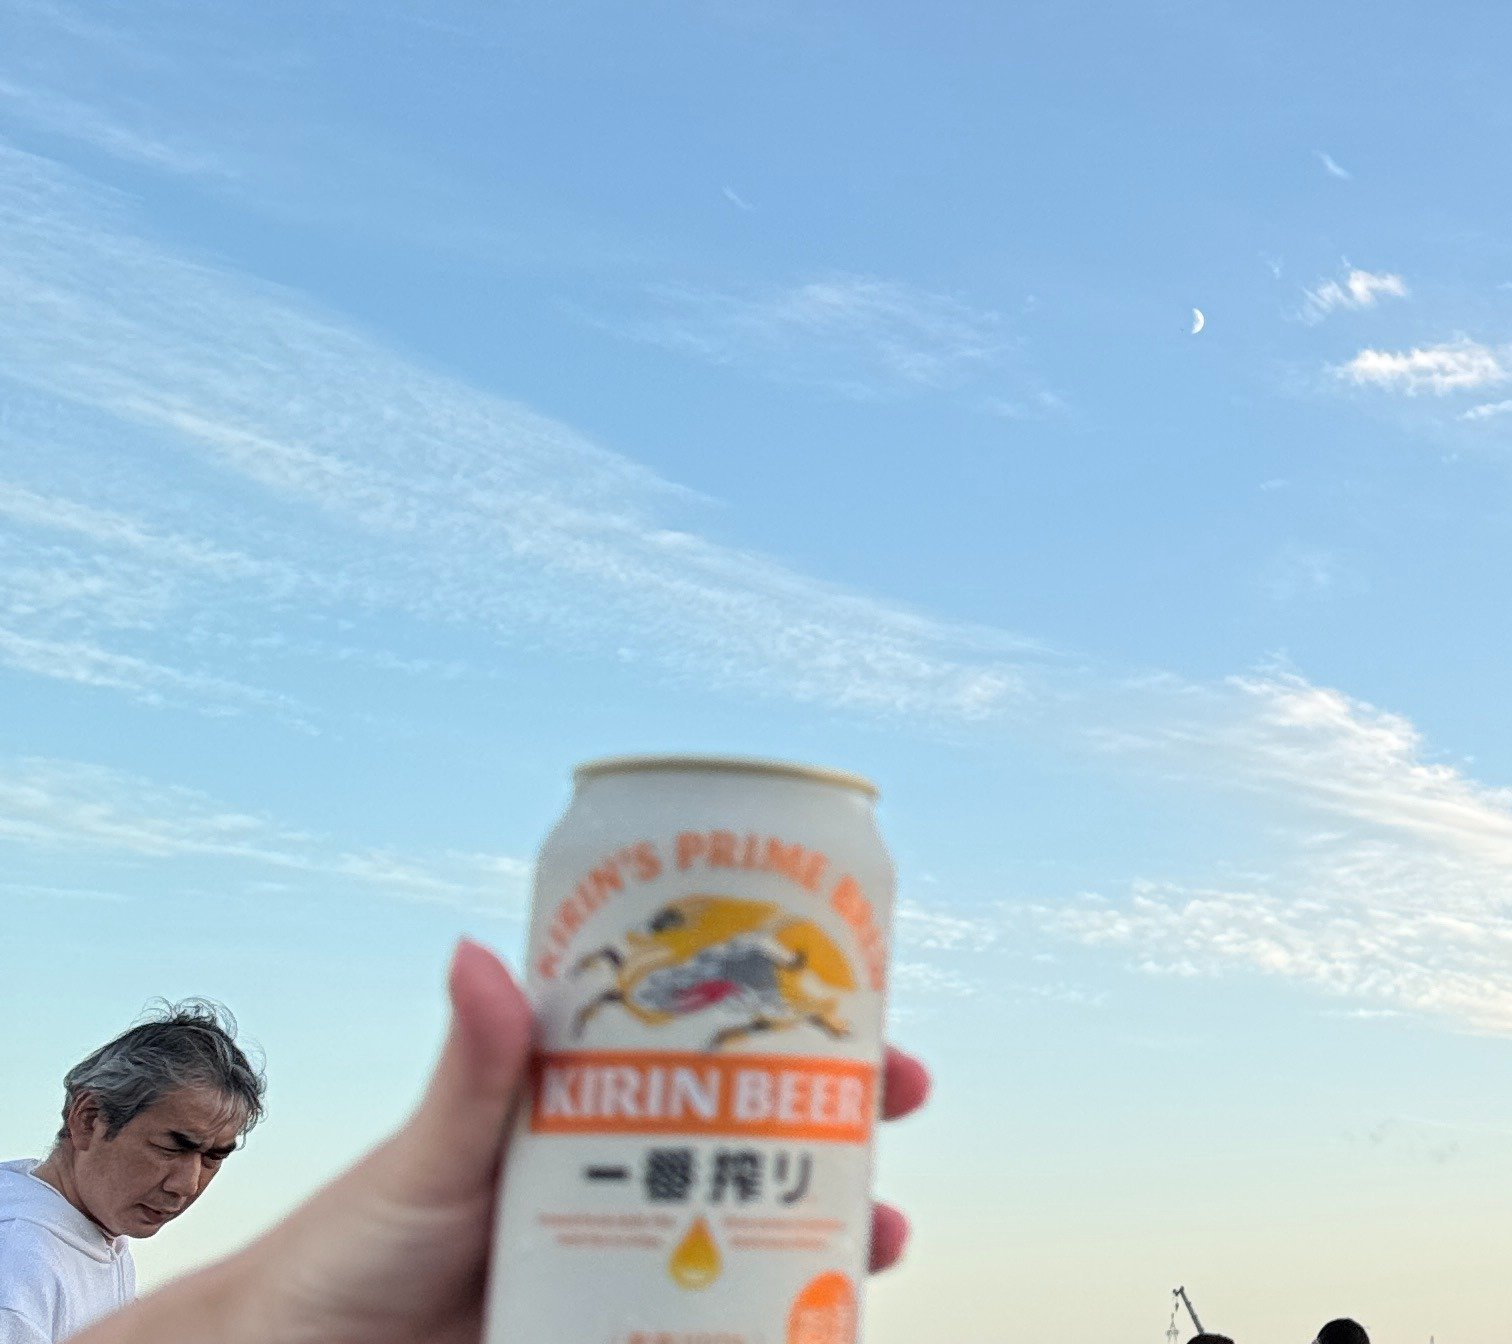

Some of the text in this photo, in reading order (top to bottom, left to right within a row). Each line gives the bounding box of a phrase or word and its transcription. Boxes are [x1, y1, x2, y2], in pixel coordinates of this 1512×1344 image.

[675, 829, 828, 894] PRIME
[541, 1065, 866, 1126] KIRIN BEER
